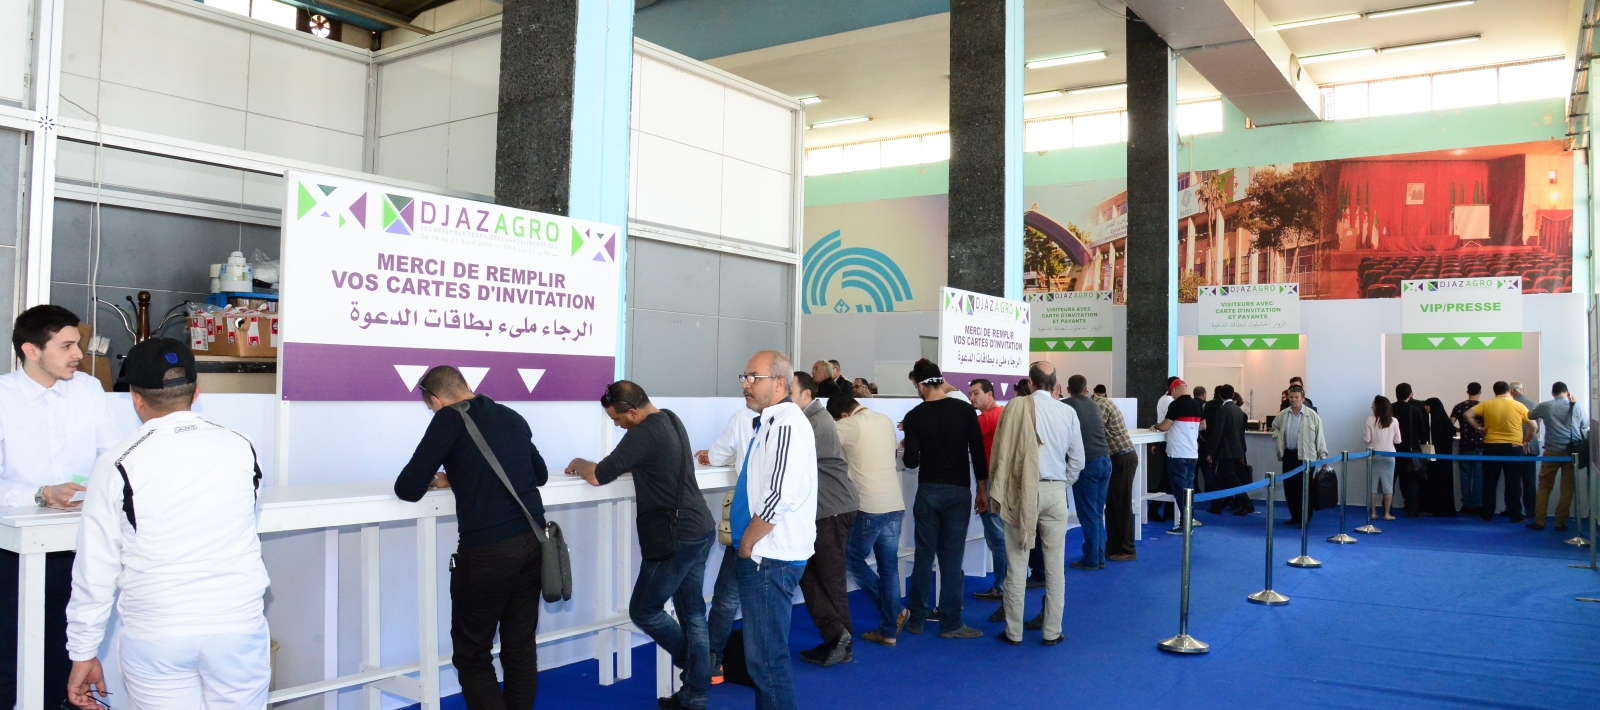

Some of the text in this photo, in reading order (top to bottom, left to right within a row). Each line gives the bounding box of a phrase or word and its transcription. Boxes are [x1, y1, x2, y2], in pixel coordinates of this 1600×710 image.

[421, 200, 560, 243] DJAZAGRO
[429, 226, 467, 237] CARREFOUR
[467, 231, 479, 239] DES
[377, 252, 566, 289] MERCI DE REMPLIR
[331, 270, 595, 310] VOS CARTES D'INVITATION
[1230, 285, 1276, 293] DJAZAGRO
[1439, 279, 1493, 288] DJAZAGRO
[975, 296, 1014, 315] DJAZAGRO
[1420, 302, 1502, 313] VIP/PRESSE
[350, 300, 418, 330] الدعوة
[424, 308, 493, 338] بطاقات
[541, 318, 593, 342] الرجاء
[964, 324, 1015, 340] MERCI DE REMPLIR
[953, 334, 1023, 351] VOS CARTES D'INVITATION
[957, 350, 976, 365] الدعوة
